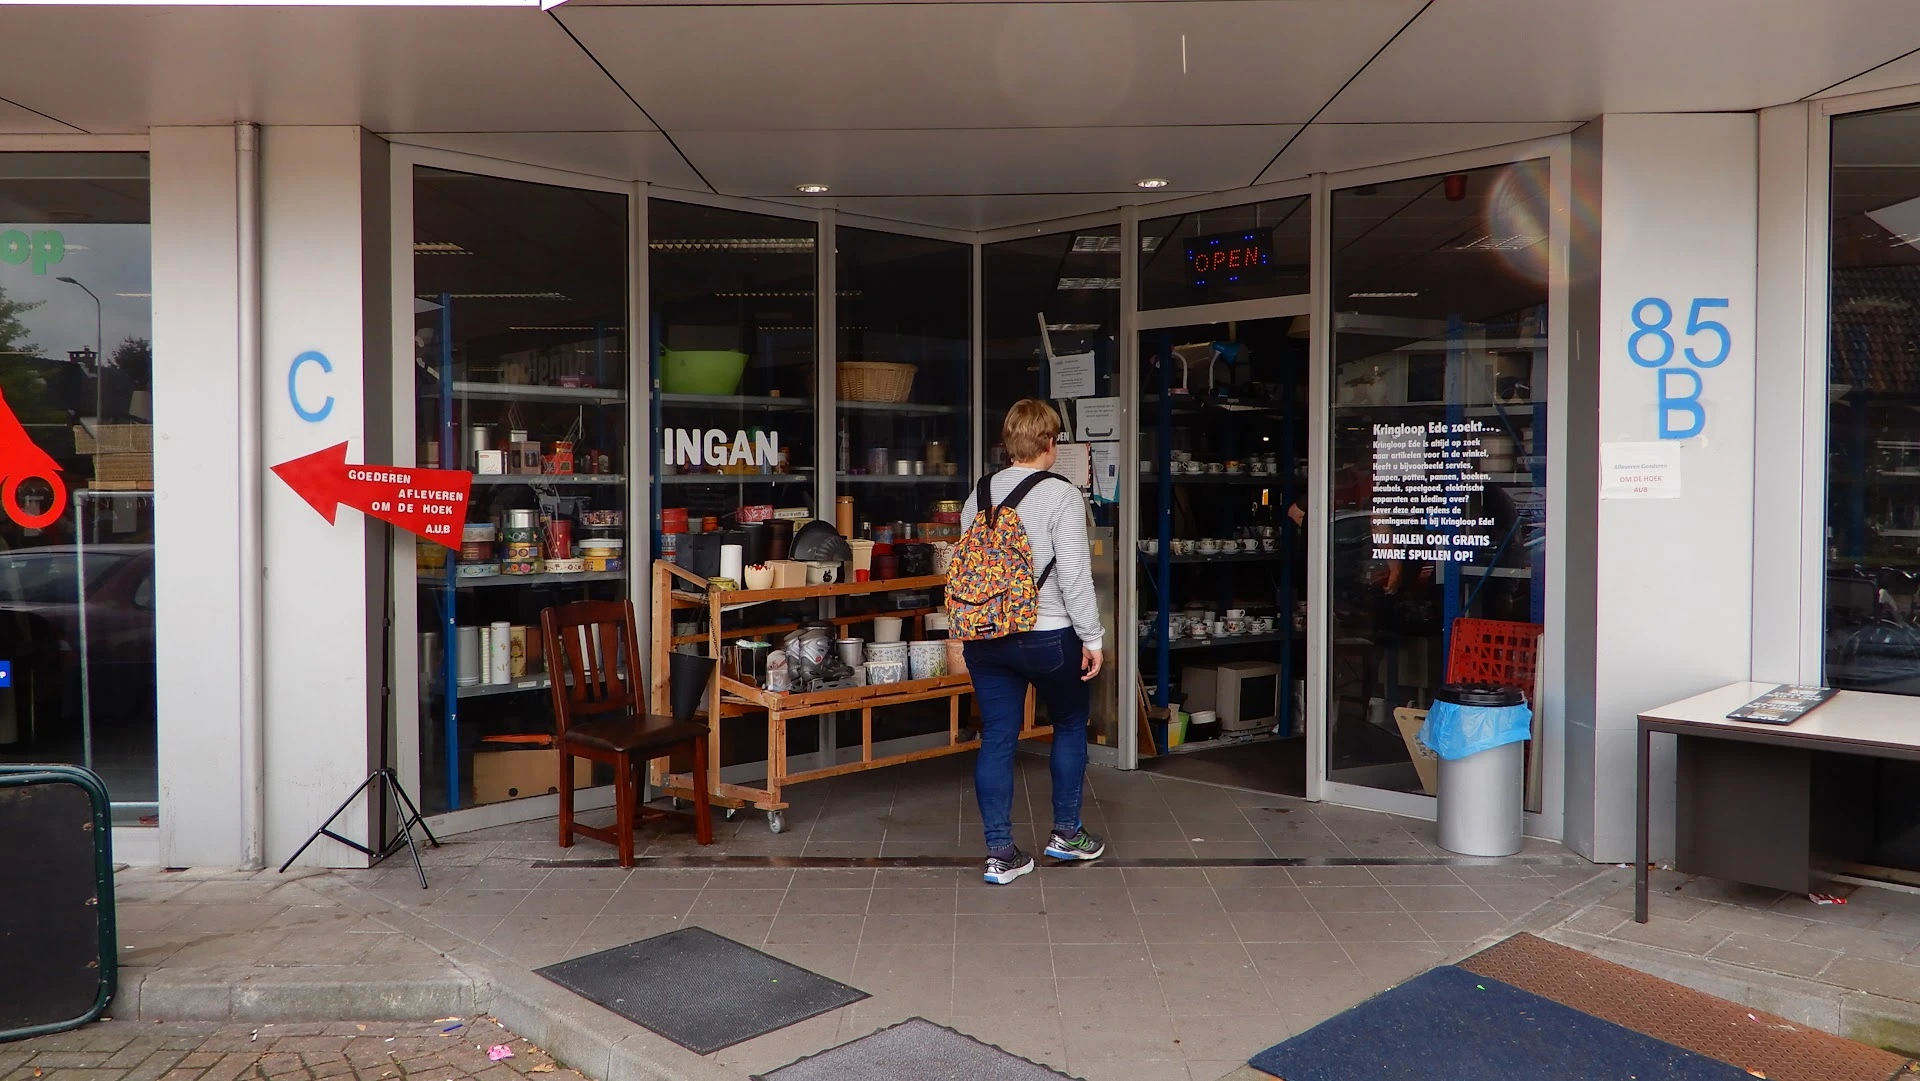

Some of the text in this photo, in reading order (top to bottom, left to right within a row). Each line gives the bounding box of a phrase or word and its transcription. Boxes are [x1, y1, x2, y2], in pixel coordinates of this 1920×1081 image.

[0, 229, 66, 276] op
[1195, 246, 1258, 273] OPEN
[1627, 297, 1732, 369] 85
[288, 350, 336, 423] C
[1658, 367, 1706, 440] B
[1373, 422, 1426, 438] Kringloop
[1428, 421, 1448, 434] Ede
[664, 428, 779, 467] INGAN
[1372, 438, 1481, 450] Kringloop Ede is altijd op zoek
[1372, 452, 1390, 460] naar
[1391, 450, 1421, 459] artikelen
[1423, 451, 1440, 459] voor
[1441, 450, 1449, 458] in
[1450, 450, 1461, 458] de
[1372, 462, 1391, 471] Heeft
[1400, 461, 1444, 472] bijvoorbeeld
[1445, 460, 1474, 470] servies,
[348, 469, 411, 484] GOEDEREN
[1429, 474, 1460, 482] pannen,
[1461, 471, 1492, 481] boeken,
[398, 489, 463, 502] AFLEVEREN
[1404, 483, 1444, 494] speelgoed,
[1445, 483, 1484, 492] elektrische
[1372, 495, 1409, 504] apparaten
[1420, 494, 1448, 505] kleding
[1449, 494, 1470, 503] over?
[371, 501, 453, 515] OM DE HOEK
[1372, 505, 1462, 516] Lever deze dan tijdens de
[425, 524, 451, 534] A.U.B
[1372, 516, 1495, 528] openingsuren in bij Kringloop Ede!
[1392, 533, 1424, 545] HALEN
[1426, 534, 1450, 546] OOK
[1452, 534, 1490, 547] GRATIS
[1372, 548, 1474, 563] ZWARE SPULLEN OP!
